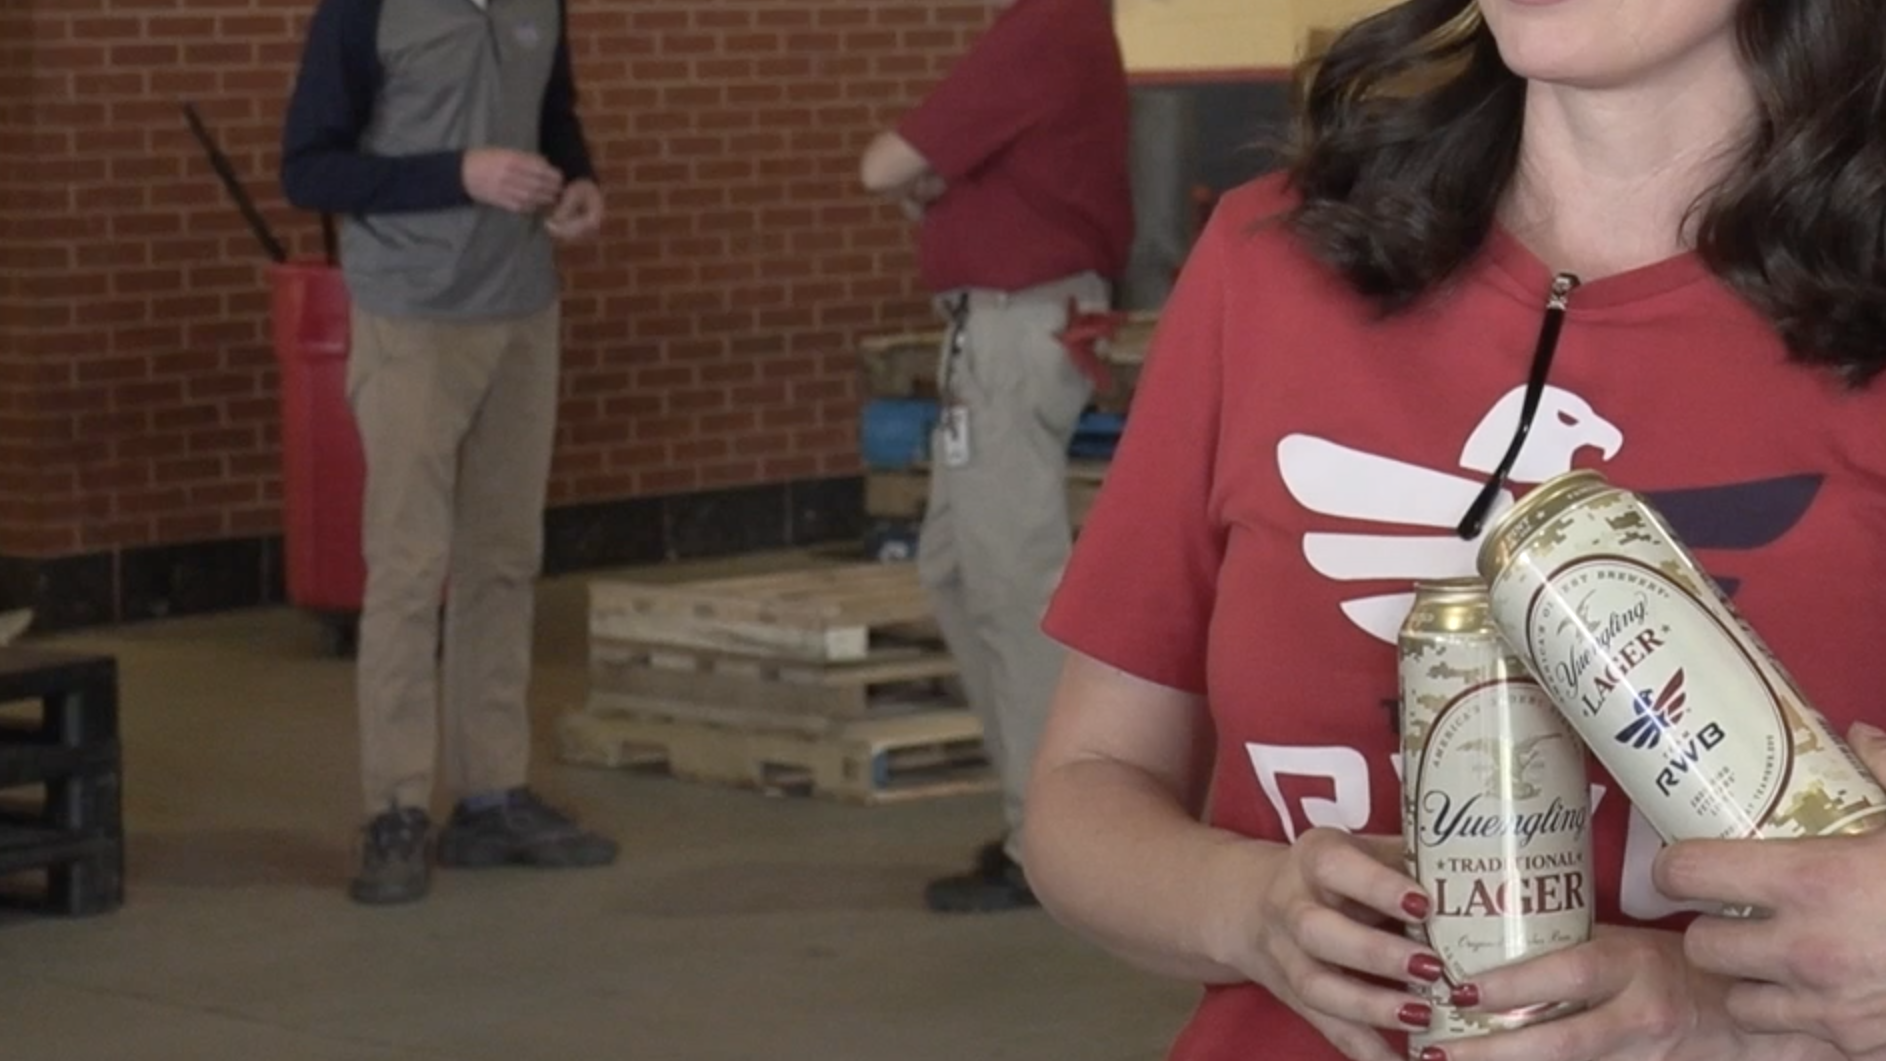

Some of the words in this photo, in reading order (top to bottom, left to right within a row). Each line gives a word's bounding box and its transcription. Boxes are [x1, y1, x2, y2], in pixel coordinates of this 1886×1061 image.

[1581, 628, 1665, 716] LAGER
[1655, 721, 1726, 797] RWB
[1419, 790, 1587, 847] Yuengling
[1448, 850, 1577, 873] TRADIONAL
[1435, 870, 1585, 917] LAGER
